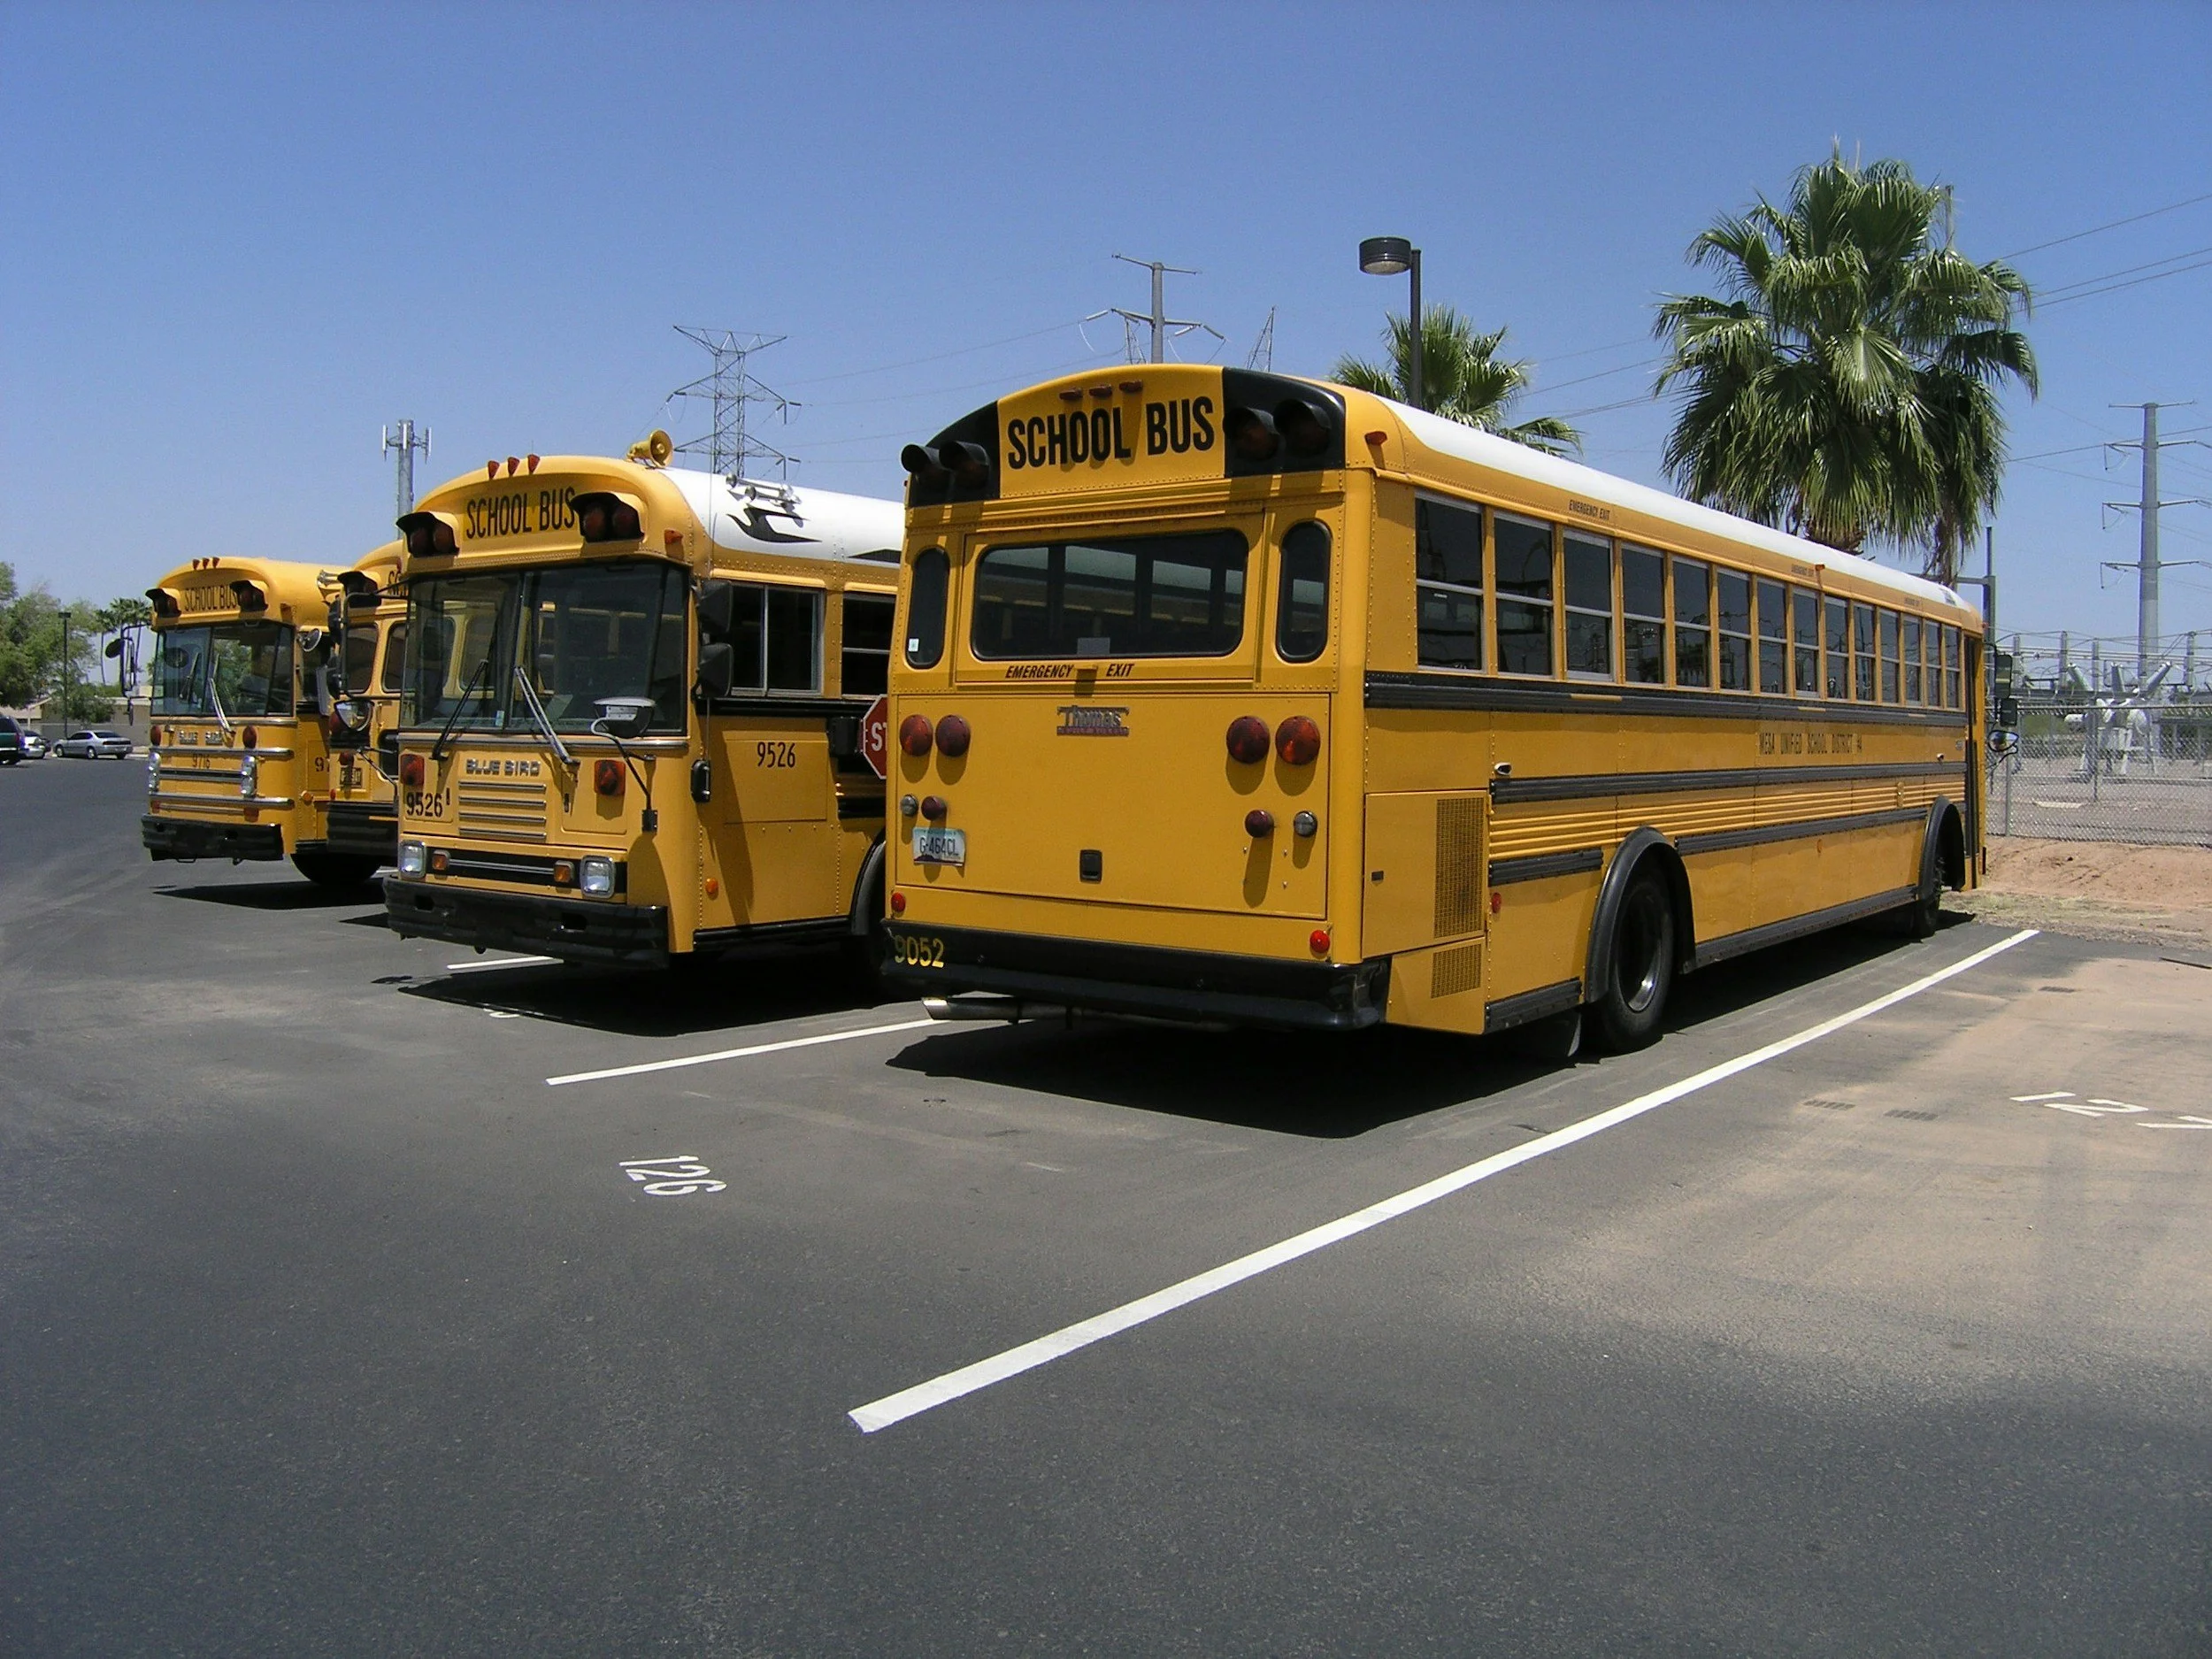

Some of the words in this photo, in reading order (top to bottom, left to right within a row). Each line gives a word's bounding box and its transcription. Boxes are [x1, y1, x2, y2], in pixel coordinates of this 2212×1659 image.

[1008, 407, 1131, 470] SCHOOL
[1146, 396, 1215, 456] BUS
[466, 493, 532, 539] SCHOOL
[540, 486, 575, 531] BUS
[184, 585, 218, 611] SCHOOL
[219, 583, 239, 609] BUS
[1005, 664, 1074, 679] EMERGENCY
[1106, 663, 1134, 677] EXIT
[466, 758, 501, 774] BLUE
[504, 760, 541, 777] BIRD
[757, 741, 795, 768] 9526
[406, 791, 443, 818] 9526
[895, 934, 944, 968] 9052
